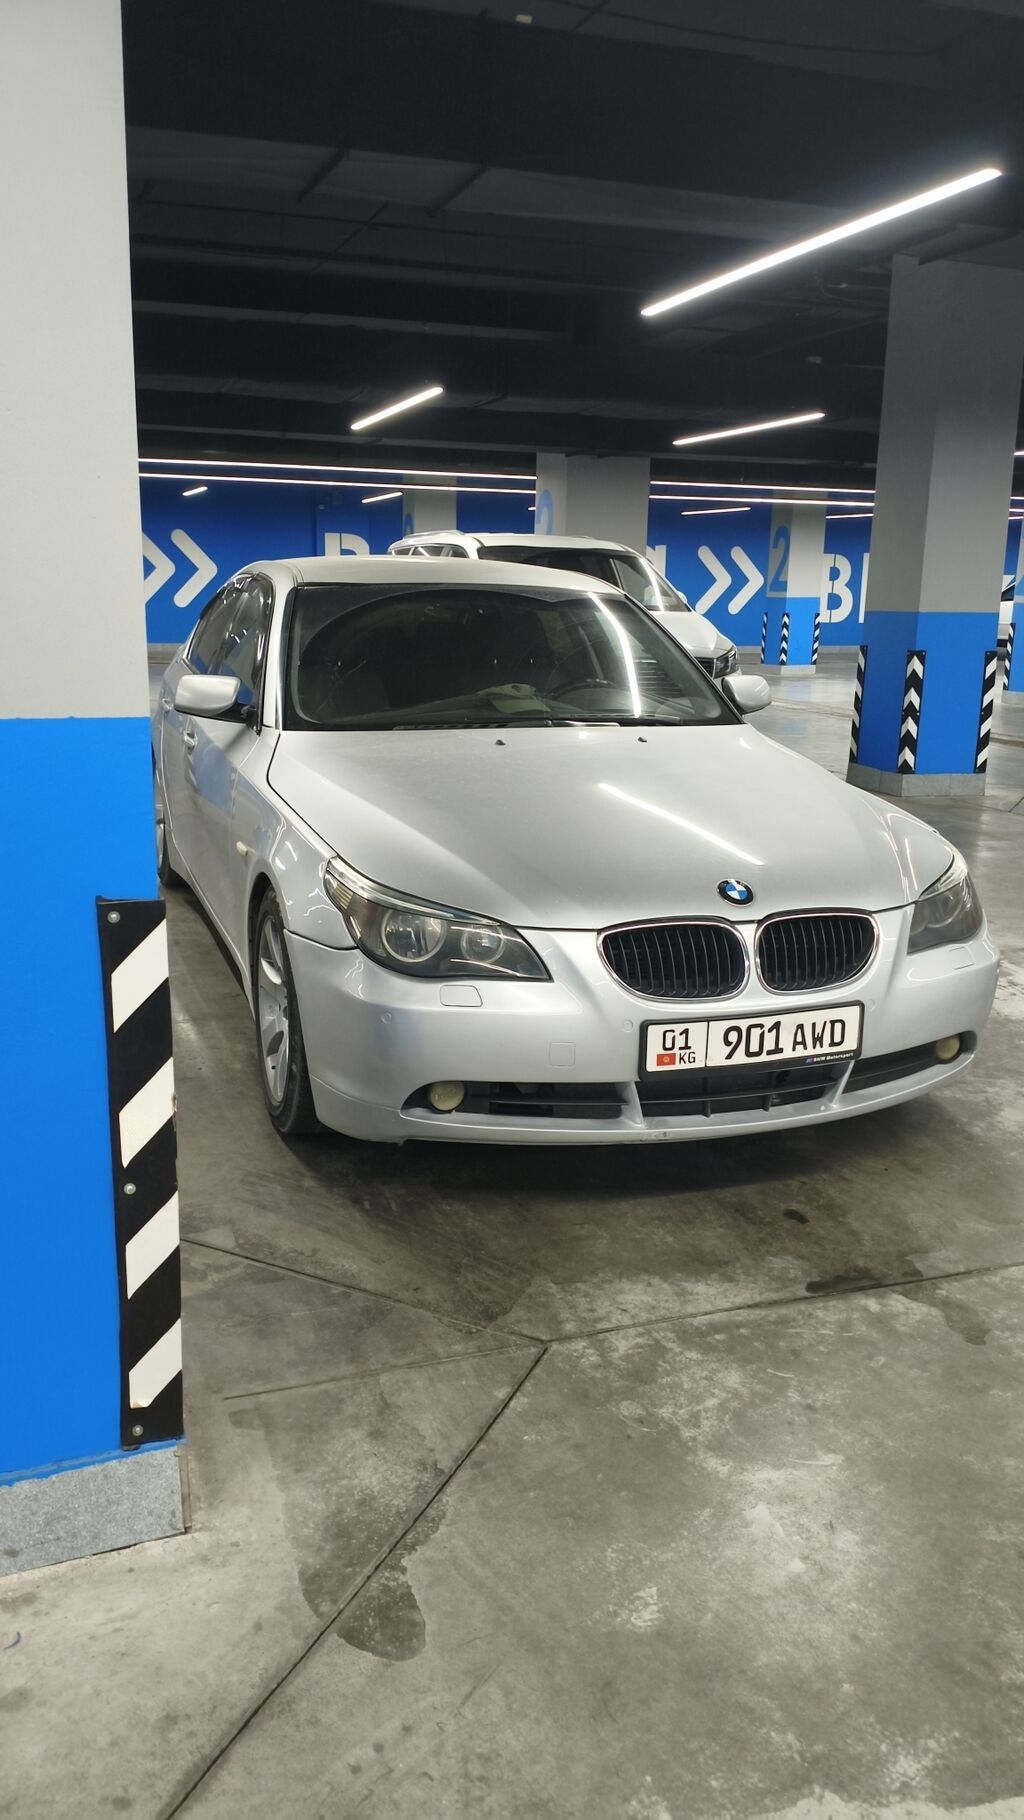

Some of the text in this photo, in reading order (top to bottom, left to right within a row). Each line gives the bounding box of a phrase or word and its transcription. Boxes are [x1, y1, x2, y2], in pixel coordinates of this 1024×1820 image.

[769, 525, 790, 592] 2
[661, 1019, 846, 1060] 01 901 AWD
[678, 1052, 696, 1064] KG
